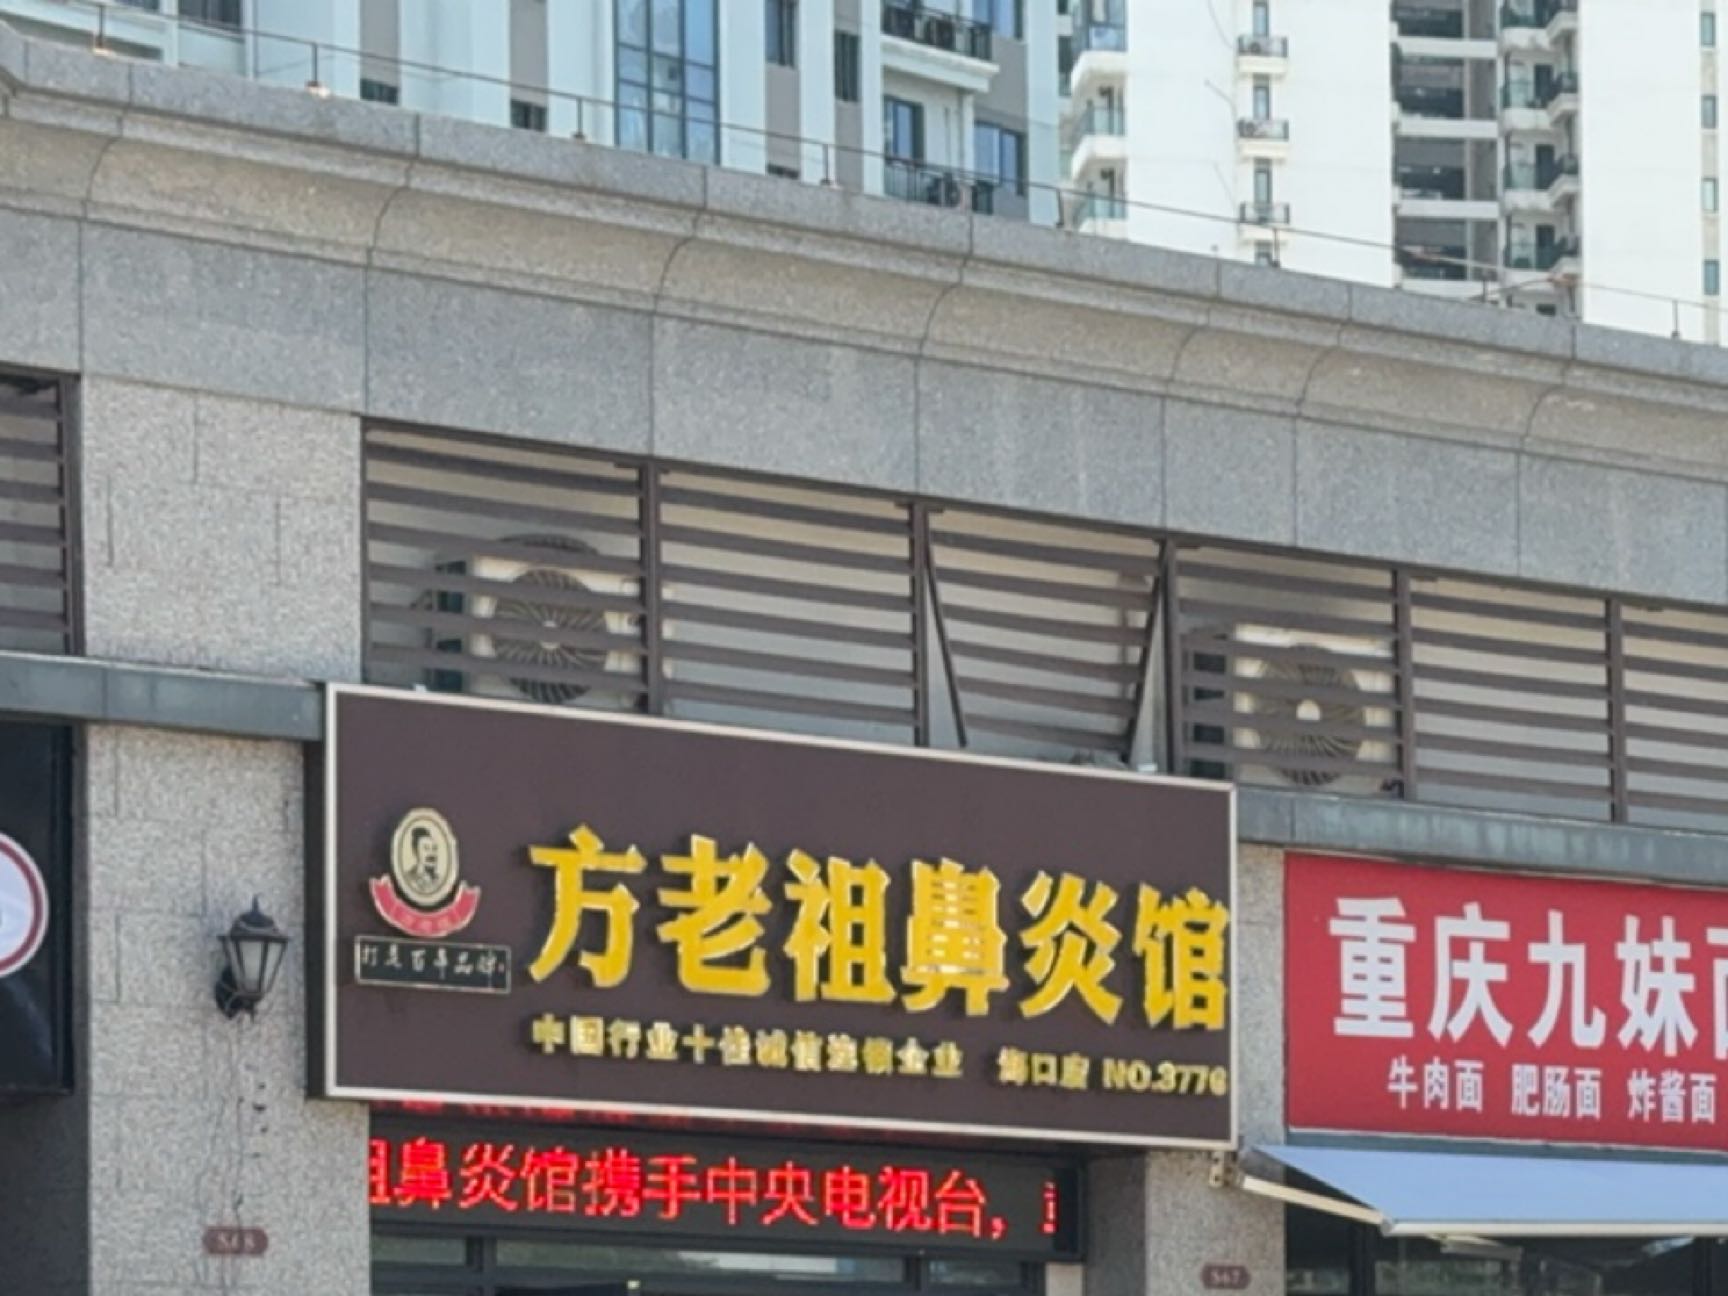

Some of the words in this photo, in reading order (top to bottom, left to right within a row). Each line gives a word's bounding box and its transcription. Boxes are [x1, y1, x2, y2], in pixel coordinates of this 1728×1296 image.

[527, 823, 1229, 1032] 方老祖鼻炎馆
[1387, 1054, 1484, 1112] 牛肉面
[1511, 1062, 1602, 1120] 肥肠面
[1627, 1069, 1718, 1124] 炸酱面
